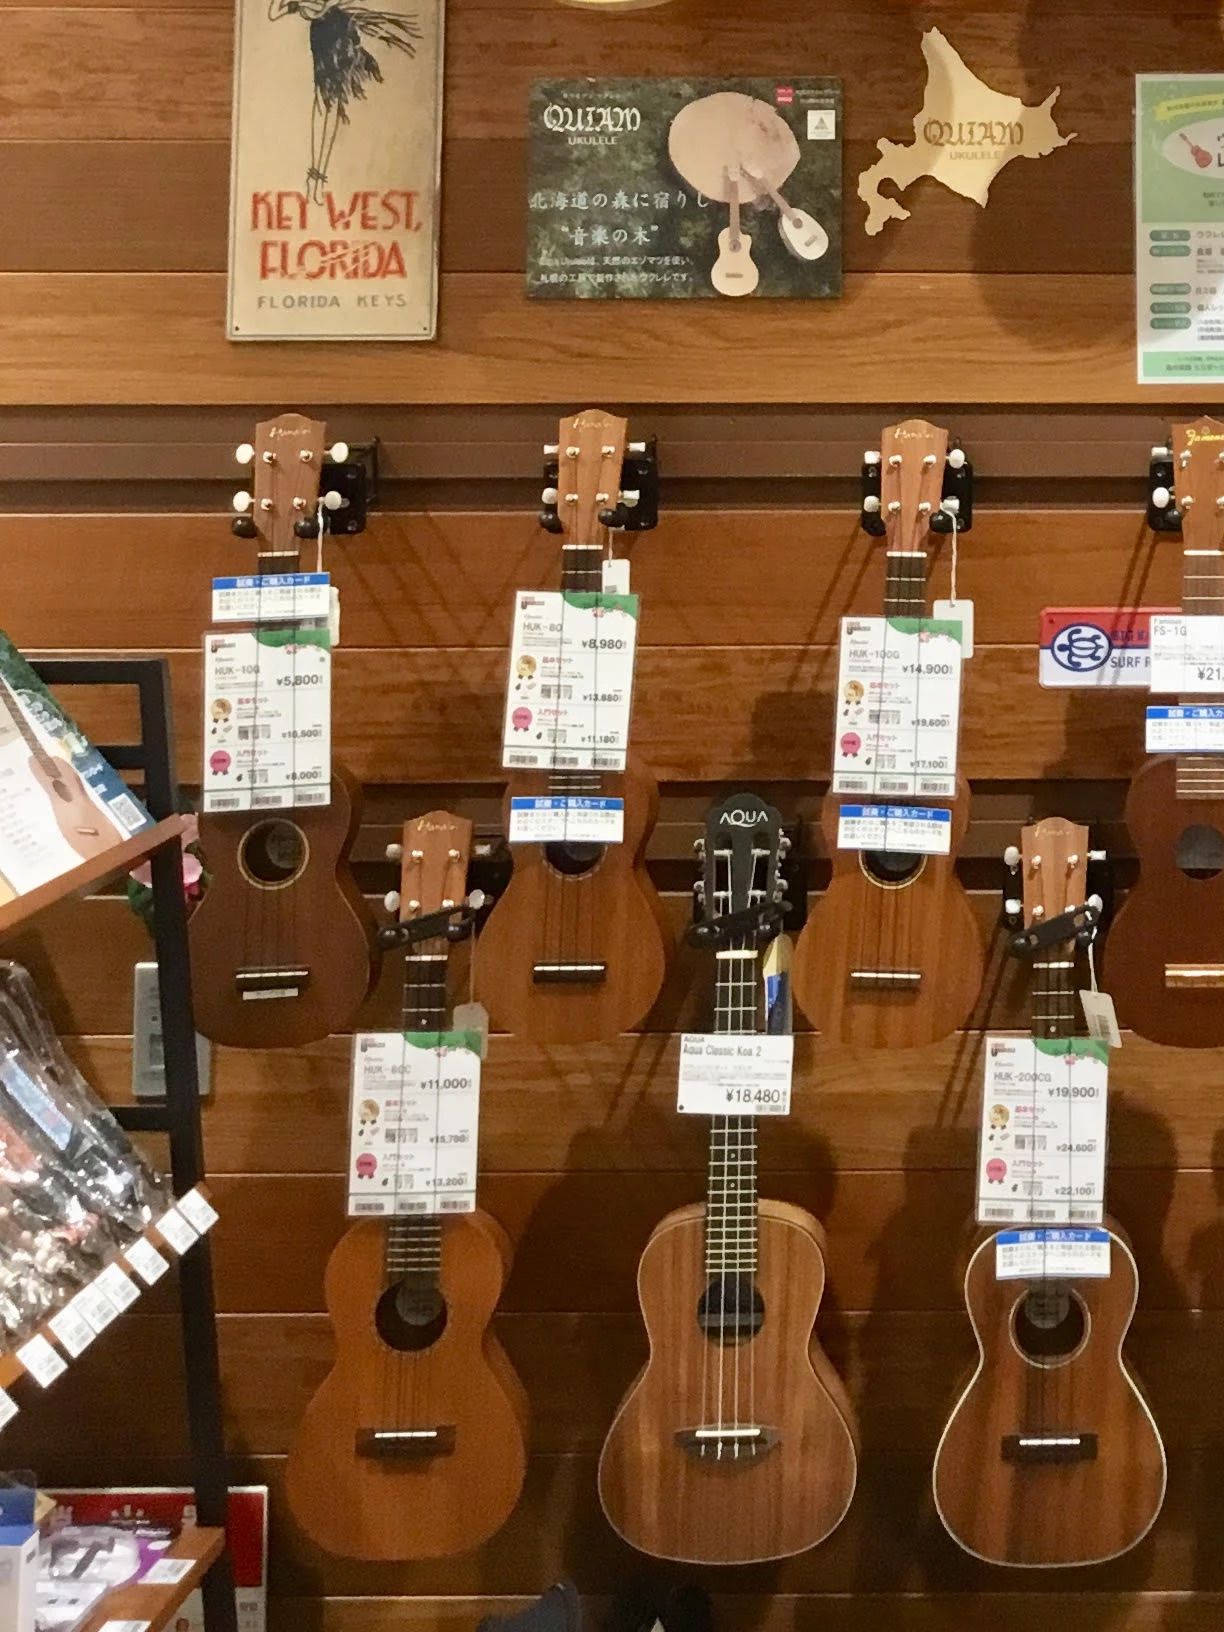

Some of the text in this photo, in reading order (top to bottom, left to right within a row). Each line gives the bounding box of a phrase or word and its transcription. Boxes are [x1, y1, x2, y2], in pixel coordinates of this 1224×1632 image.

[568, 136, 618, 145] UKULELE
[949, 151, 1000, 160] UKULELE
[529, 191, 709, 209] 北海道の森に宿りし
[251, 190, 309, 232] KEY
[260, 240, 407, 280] FLORIDA
[257, 294, 407, 310] FLORIDA KEYS
[582, 639, 623, 649] ¥8,980
[1110, 656, 1141, 668] SURF
[902, 664, 949, 674] ¥14,900
[277, 674, 319, 686] ¥5,800
[720, 809, 768, 827] AQUA
[737, 1046, 752, 1056] Koa
[756, 1046, 761, 1056] 2
[421, 1077, 468, 1089] ¥11,000
[726, 1089, 780, 1103] ¥18,480
[1048, 1087, 1095, 1097] ¥19,900
